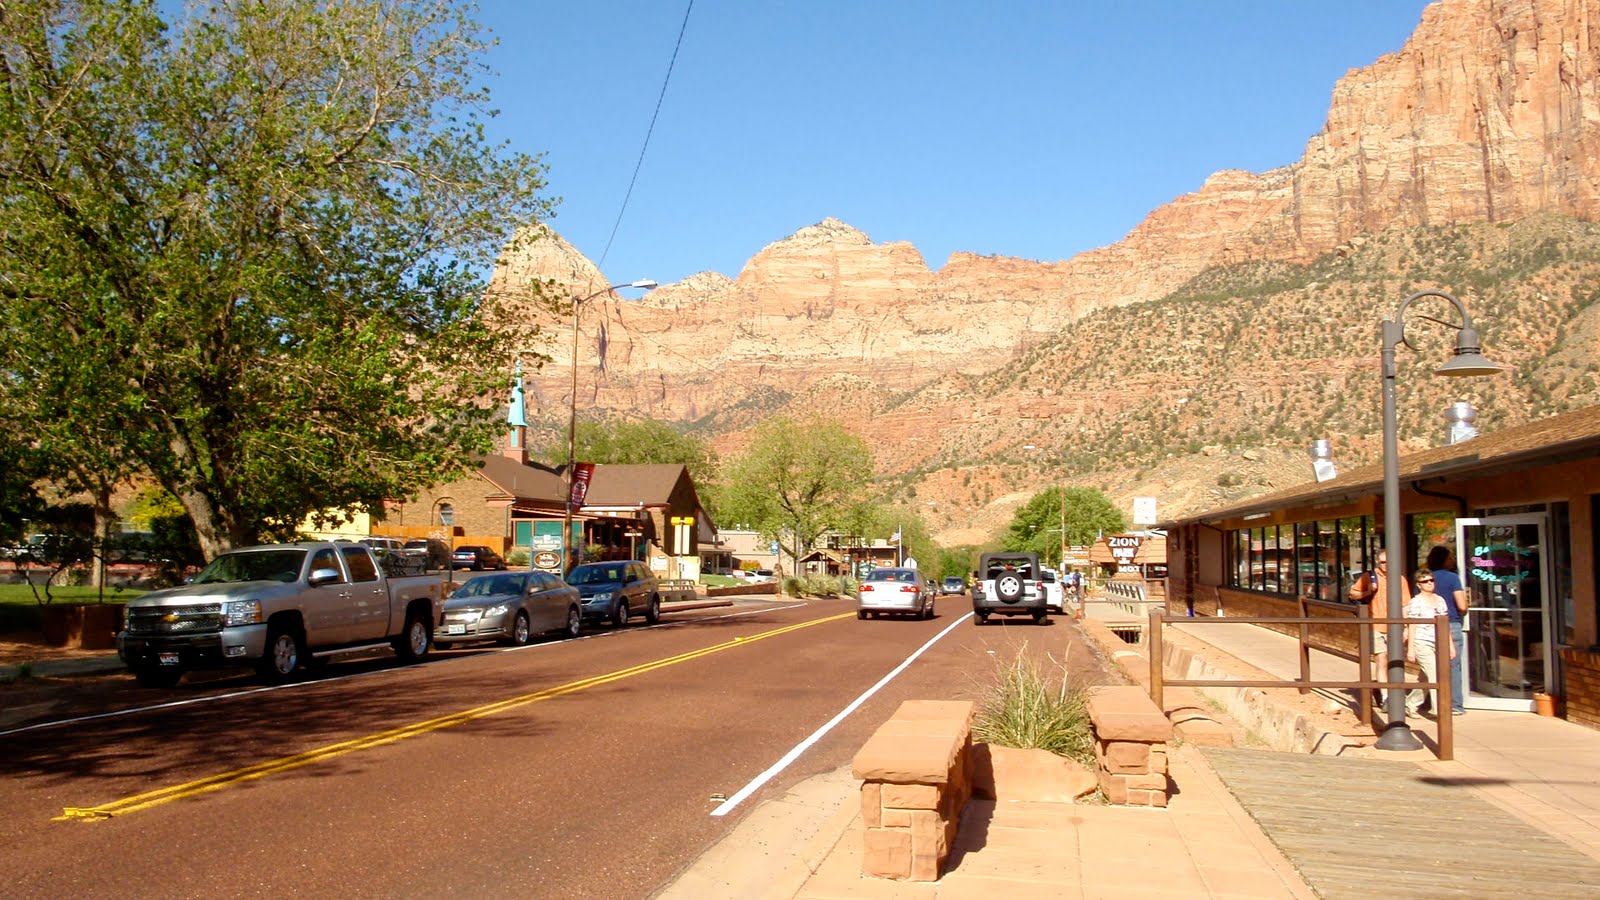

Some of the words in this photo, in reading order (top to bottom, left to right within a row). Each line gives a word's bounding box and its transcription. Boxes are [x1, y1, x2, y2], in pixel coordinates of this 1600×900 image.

[1489, 527, 1512, 536] 897
[1108, 537, 1139, 547] ZION
[1113, 547, 1134, 557] PARK
